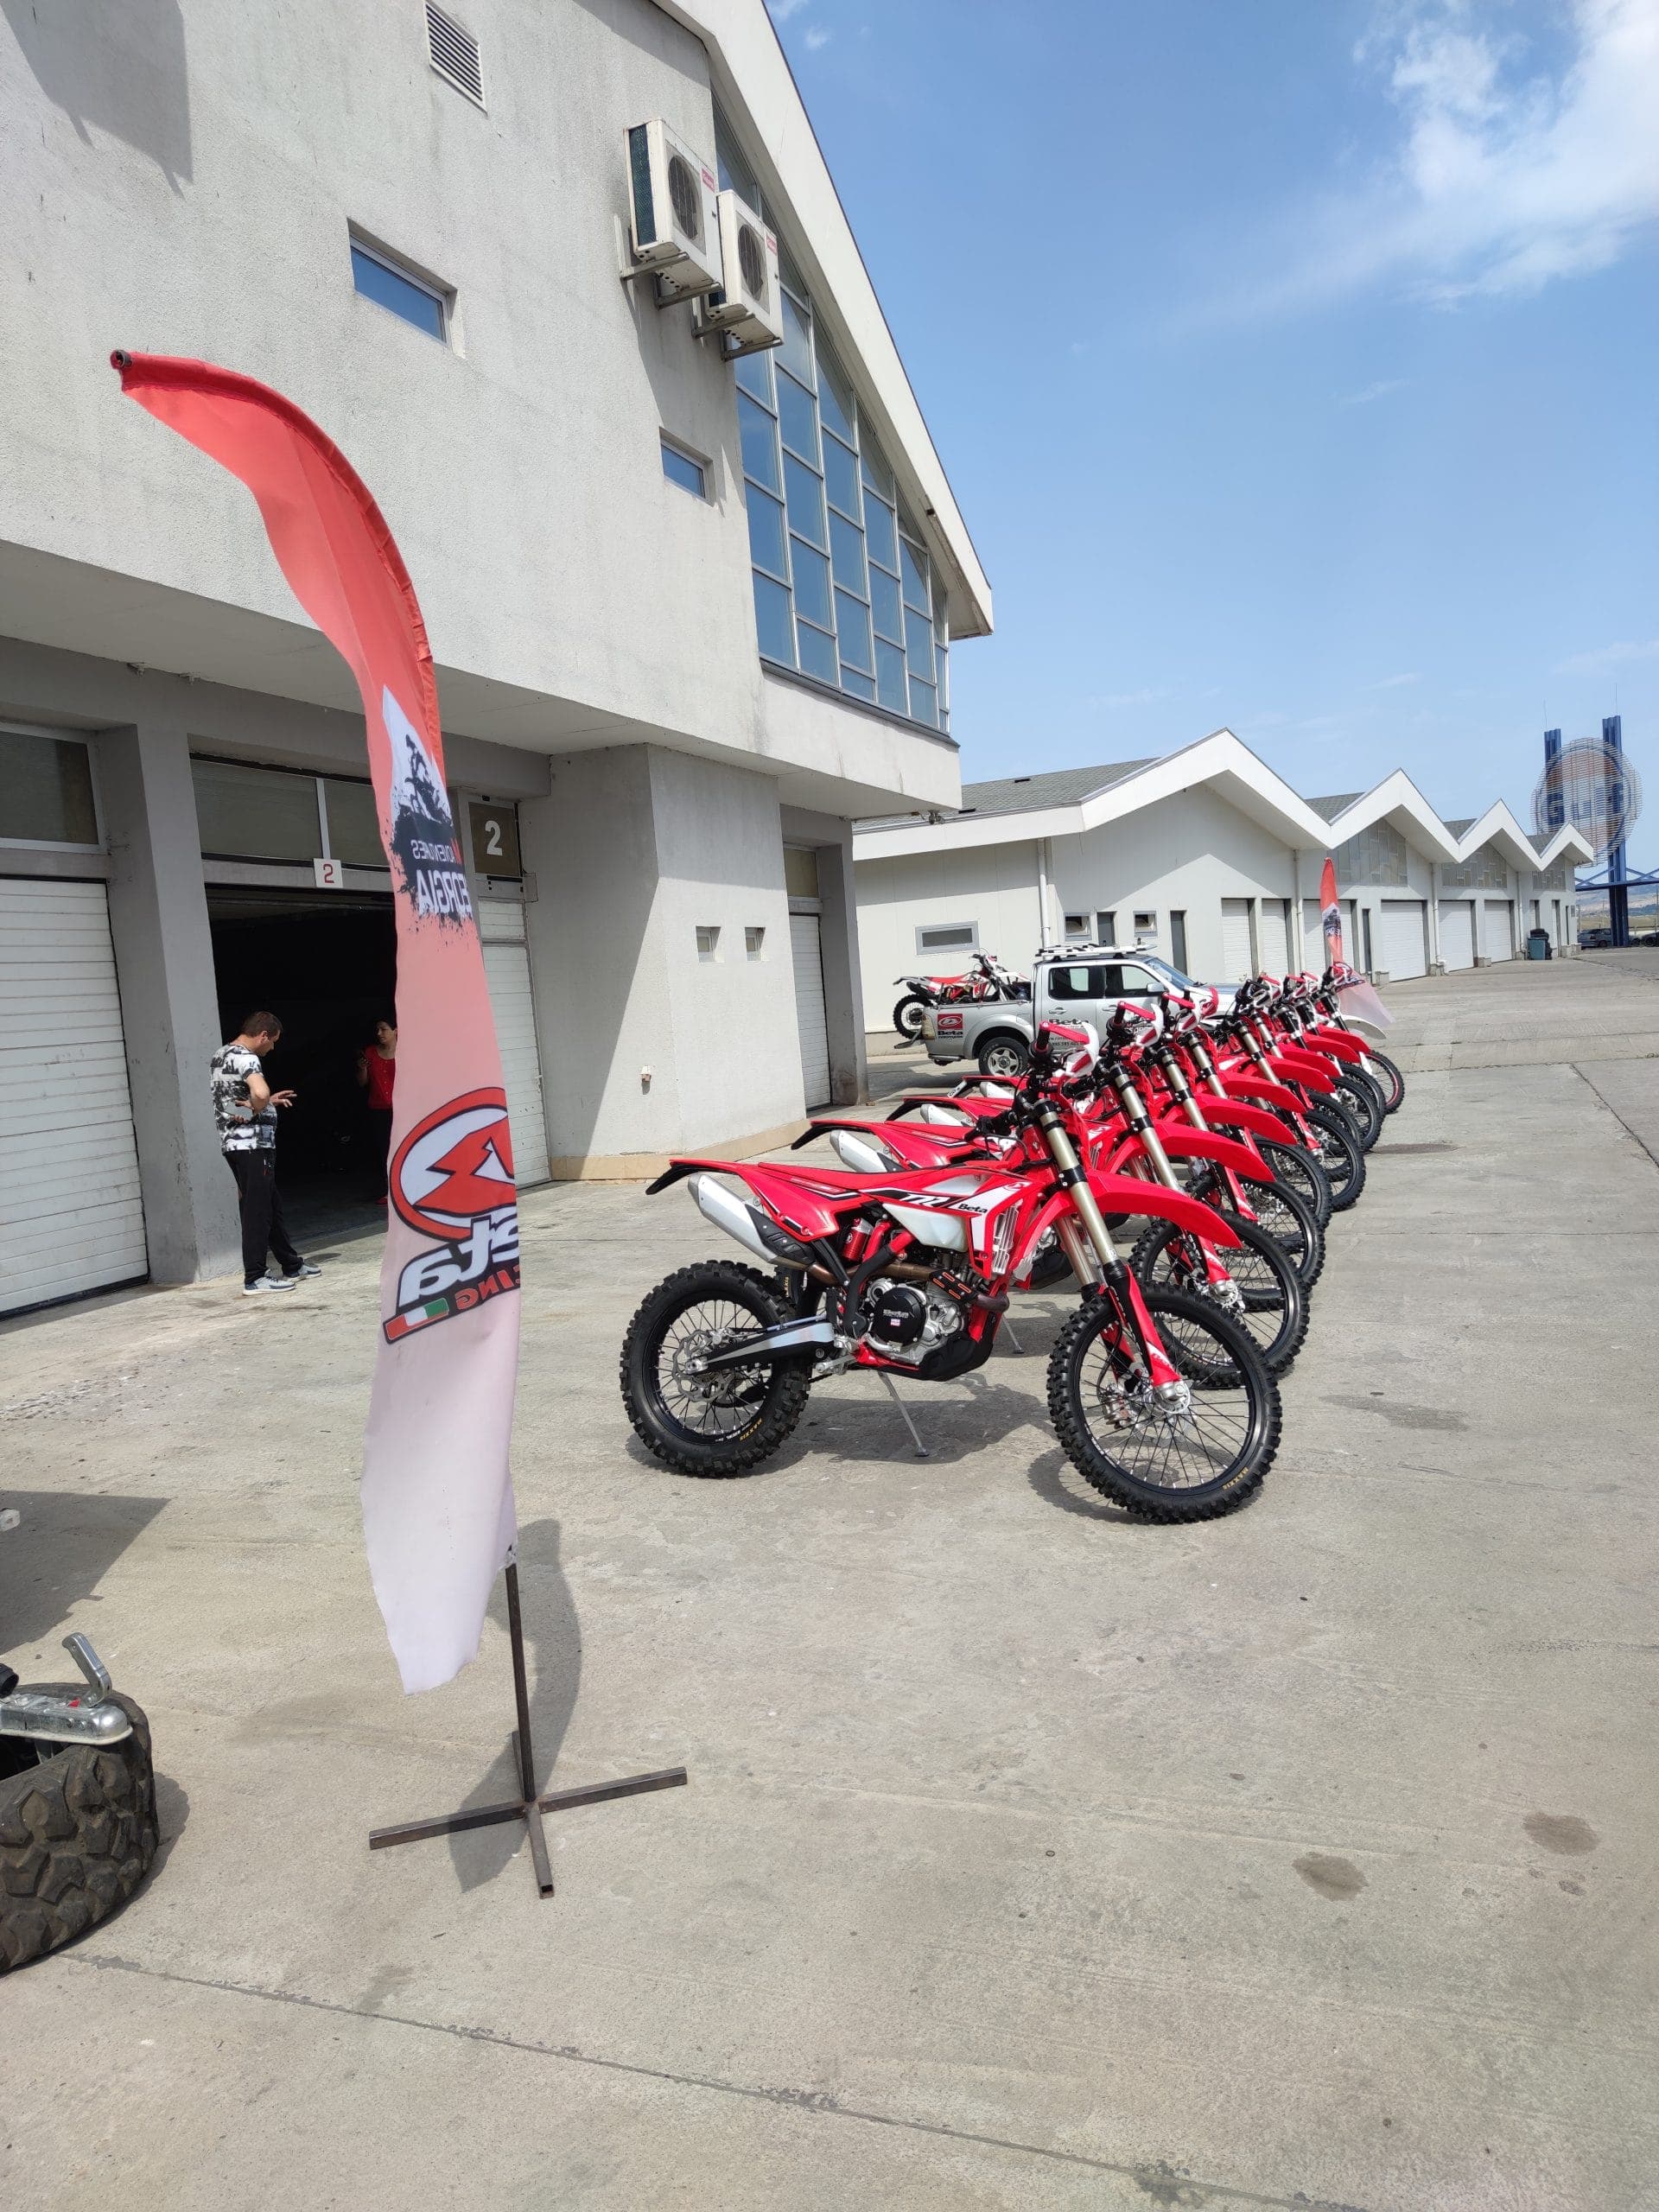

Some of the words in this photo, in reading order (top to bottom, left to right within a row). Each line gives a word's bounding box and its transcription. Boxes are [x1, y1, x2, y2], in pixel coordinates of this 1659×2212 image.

[485, 820, 503, 856] 2
[322, 863, 334, 884] 2
[957, 1203, 988, 1214] Beta
[1222, 1466, 1249, 1491] MAXXIS
